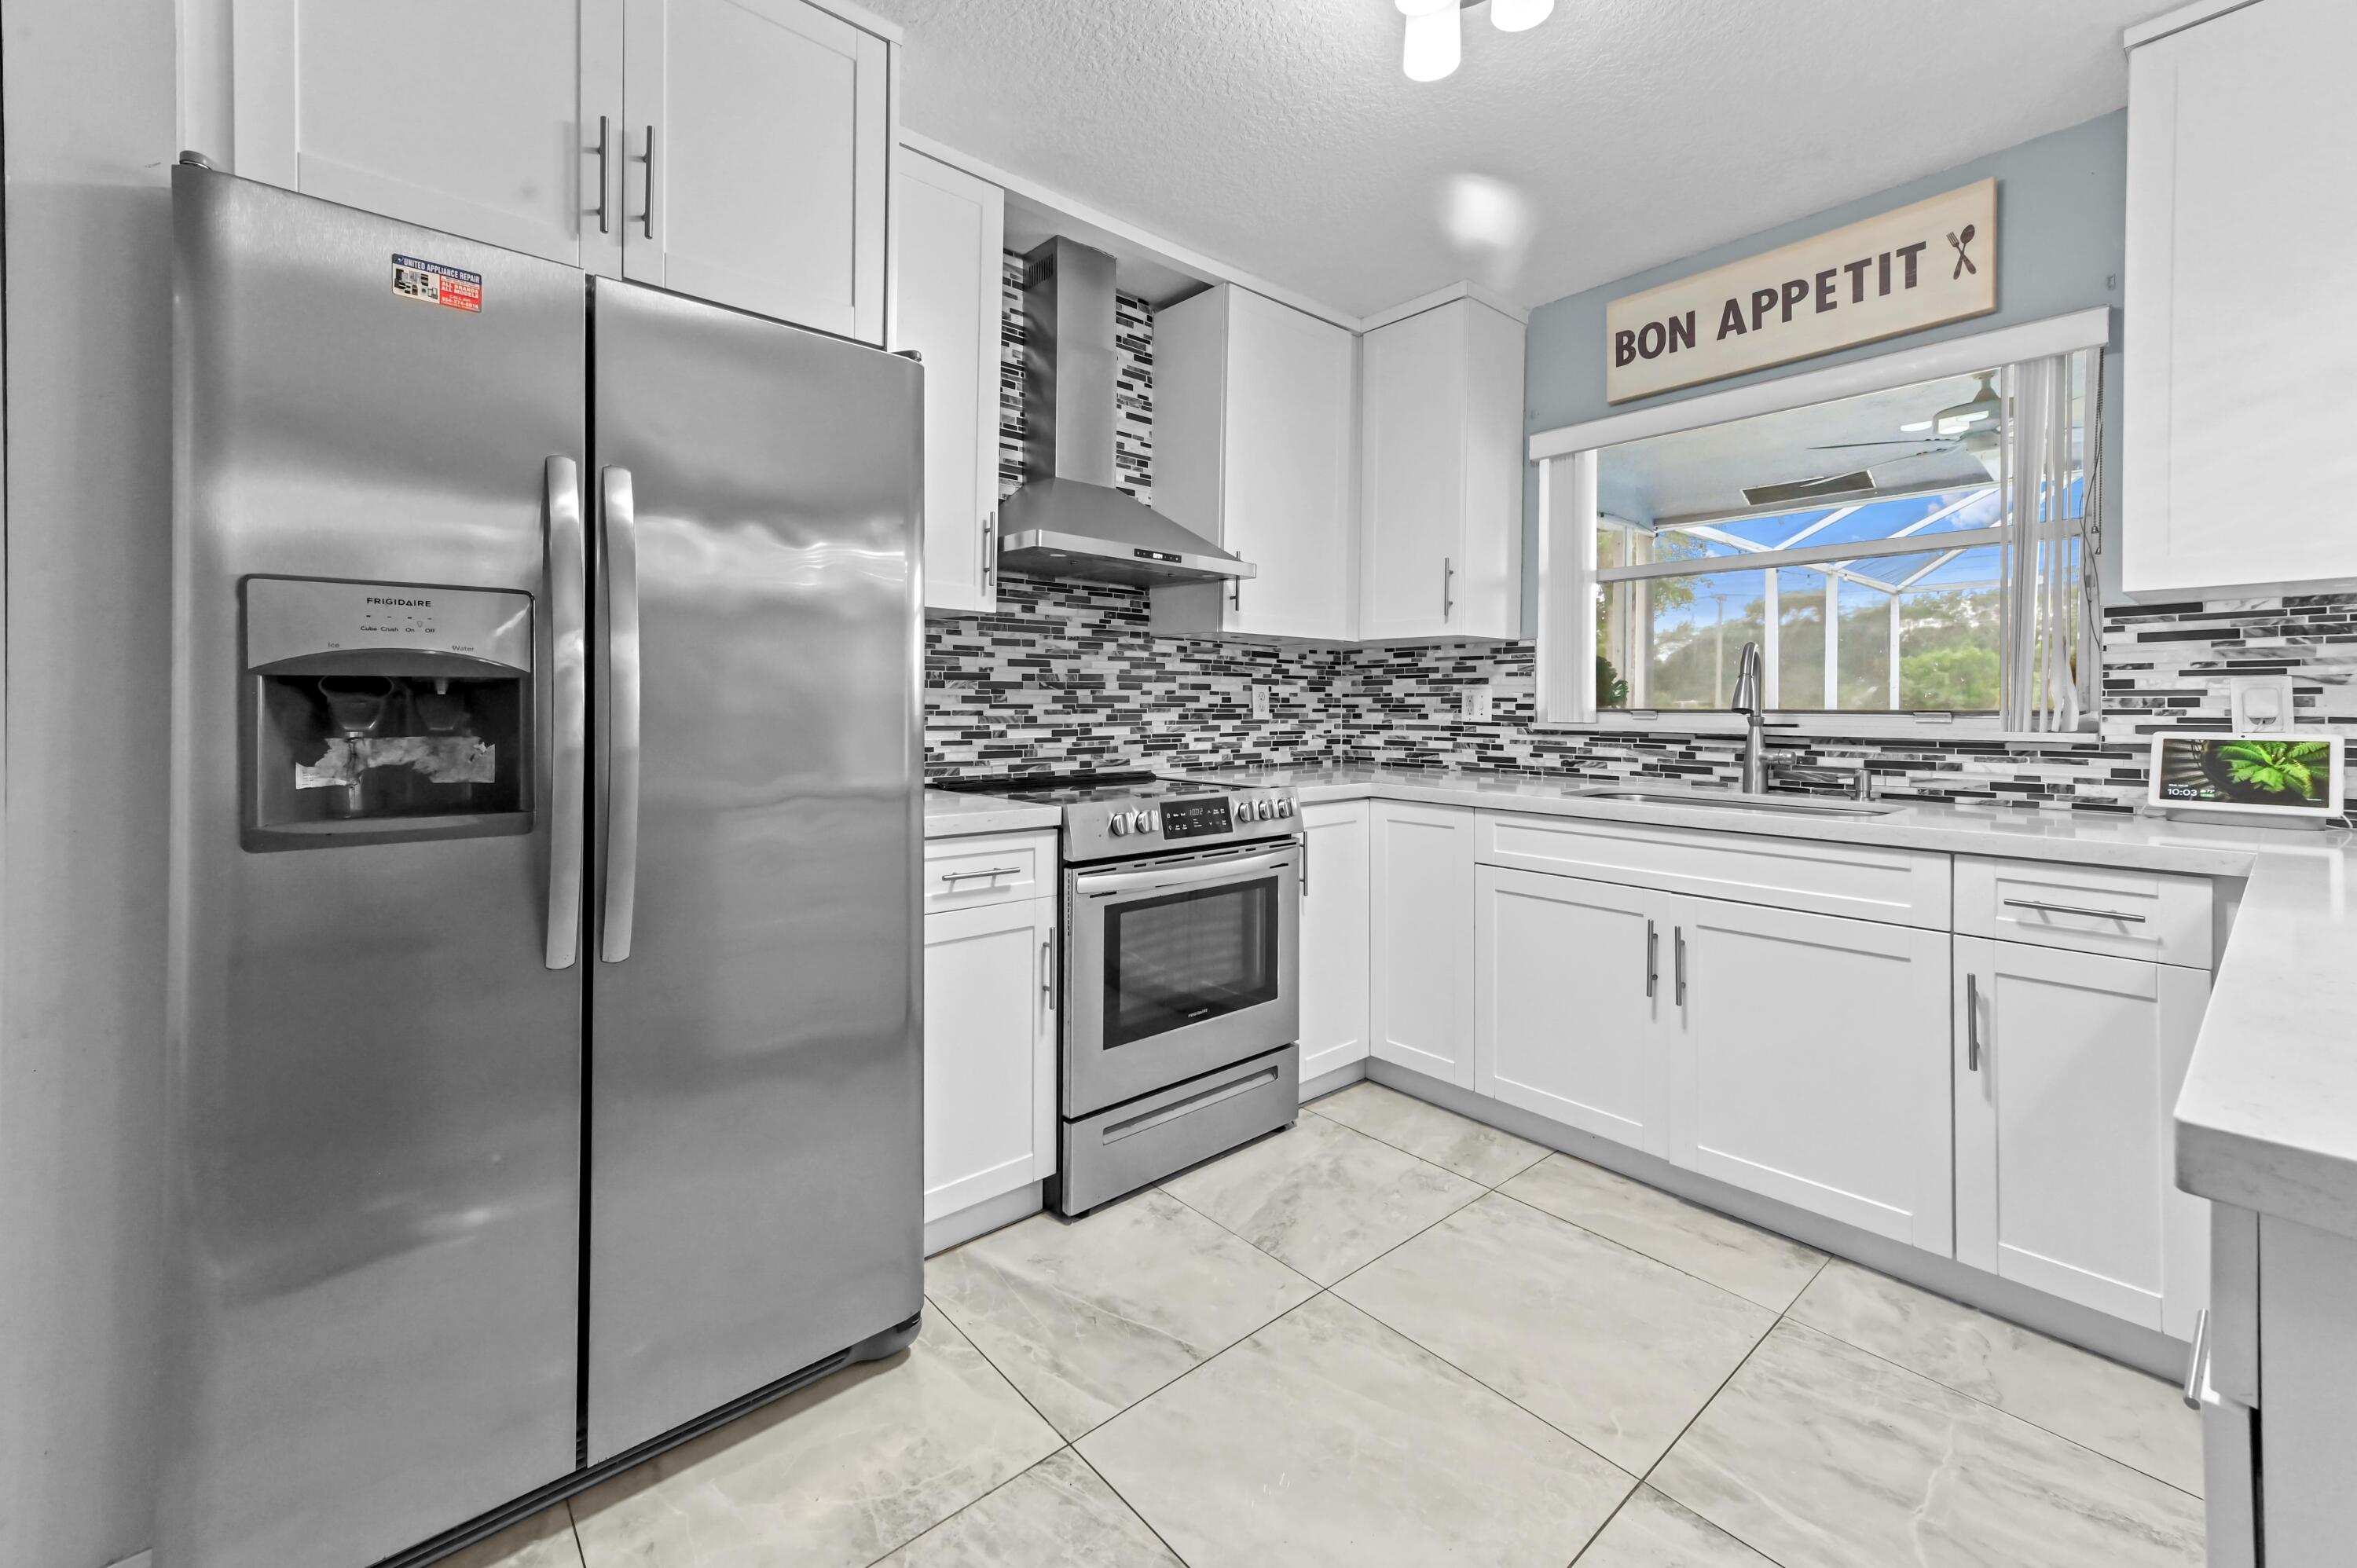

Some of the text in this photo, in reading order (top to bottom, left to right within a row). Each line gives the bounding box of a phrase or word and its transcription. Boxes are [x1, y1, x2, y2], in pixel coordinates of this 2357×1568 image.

[404, 258, 425, 270] UNITED
[427, 263, 458, 278] APPLIANCE
[460, 272, 480, 284] REPAIR
[454, 284, 478, 294] BRANDS
[454, 289, 478, 299] MODELS
[1615, 241, 1926, 368] BON APPETIT
[366, 597, 431, 607] FRIGIDAIRE
[2167, 788, 2198, 797] 10:03
